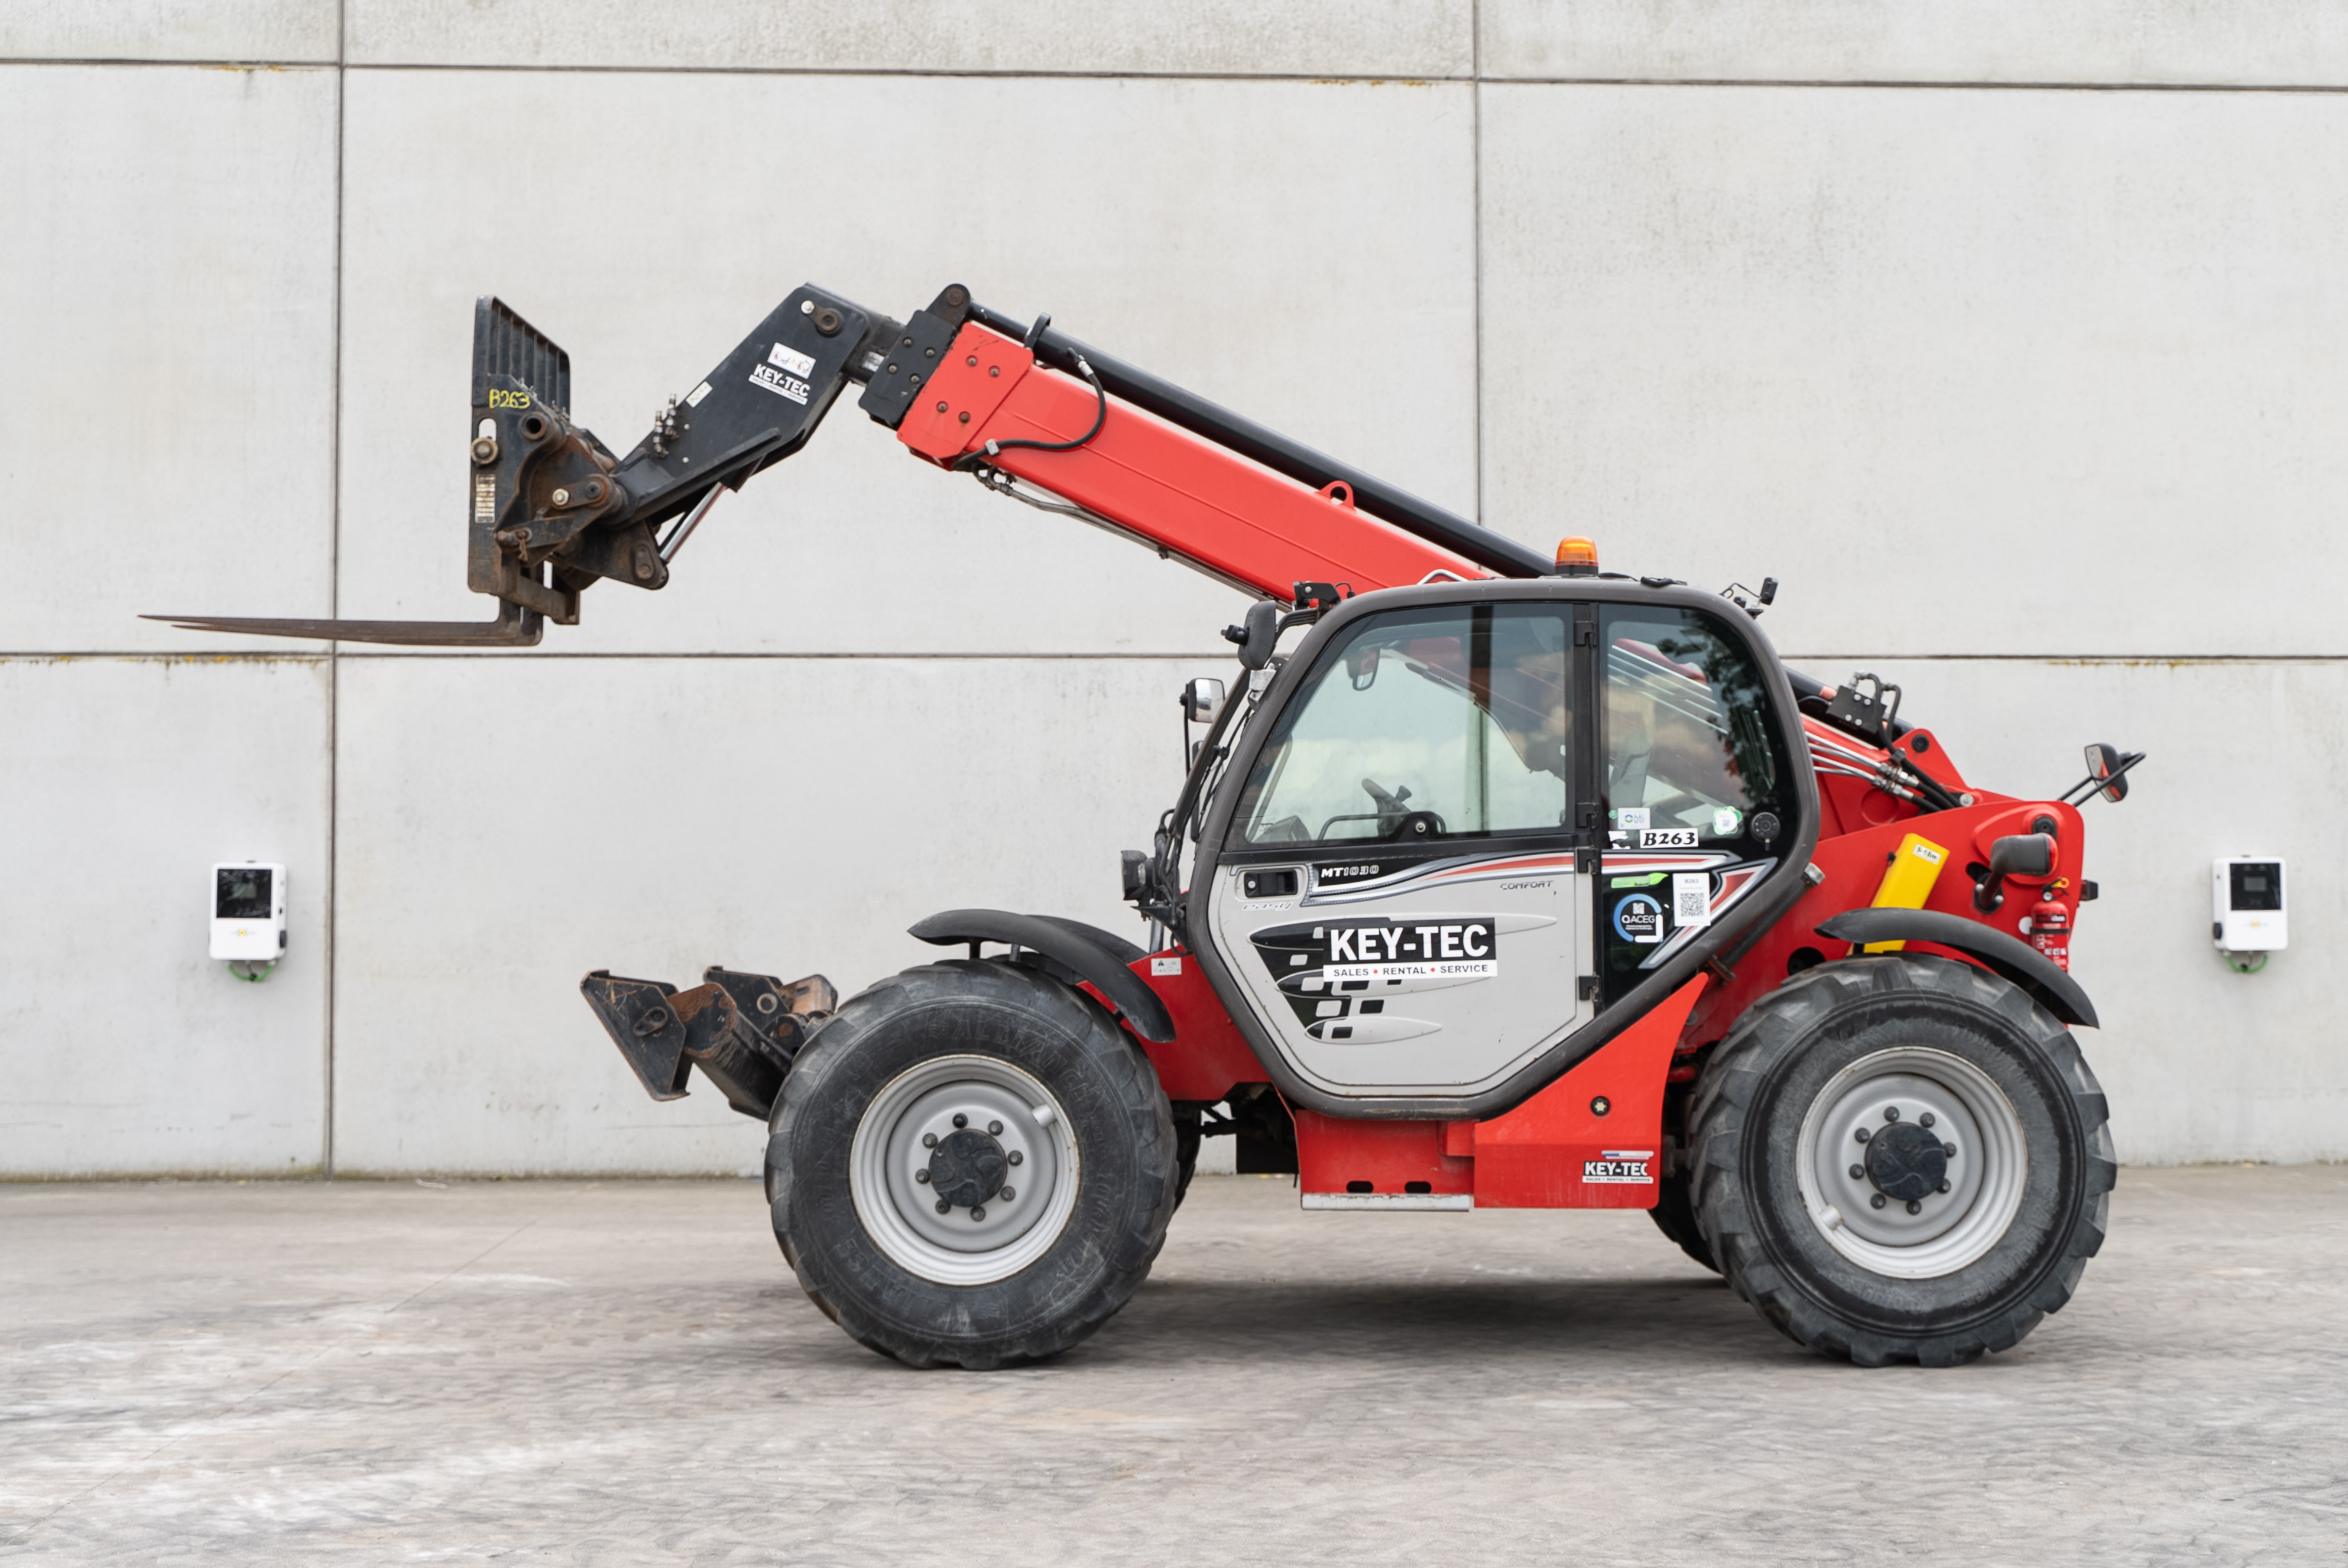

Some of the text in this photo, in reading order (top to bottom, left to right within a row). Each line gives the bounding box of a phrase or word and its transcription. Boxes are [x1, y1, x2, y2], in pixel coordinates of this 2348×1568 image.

[753, 363, 810, 397] KEY-TEC
[489, 388, 531, 409] B263
[1643, 832, 1695, 846] B263
[1321, 865, 1379, 878] MT1030
[1500, 879, 1554, 890] COMFORT
[1241, 901, 1294, 911] easy
[1329, 924, 1489, 962] KEY-TEC
[1333, 964, 1488, 978] SALES RENTAL SERVICE
